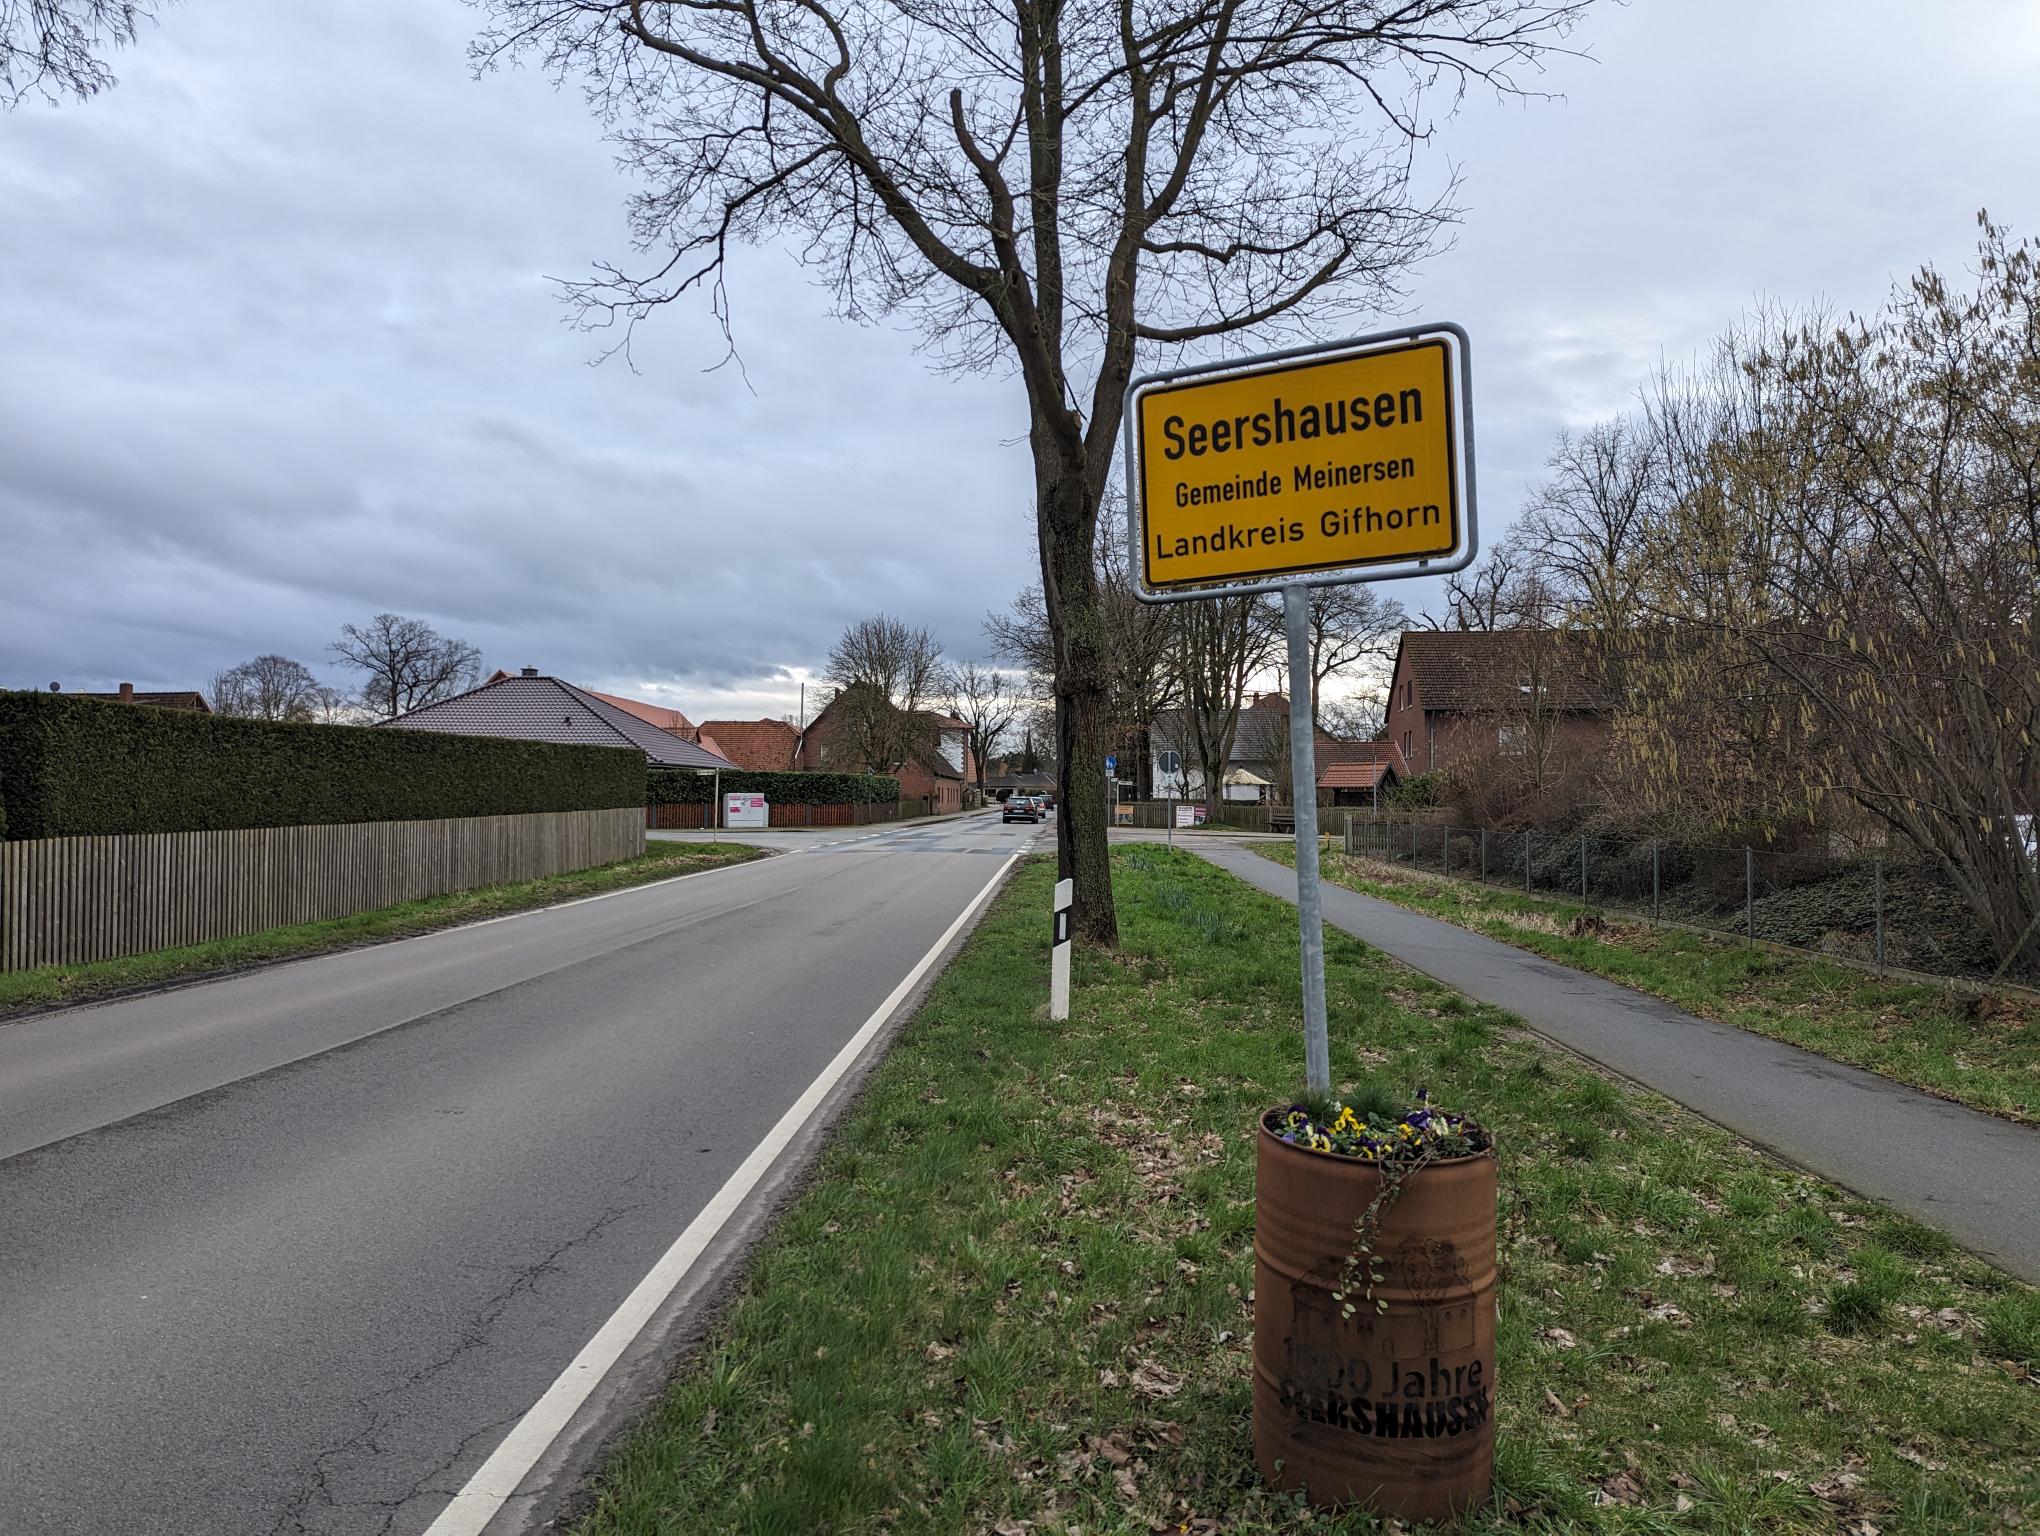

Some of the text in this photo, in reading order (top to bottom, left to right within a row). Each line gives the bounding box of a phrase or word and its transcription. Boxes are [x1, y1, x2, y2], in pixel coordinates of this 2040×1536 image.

[1163, 387, 1423, 460] Seershausen
[1175, 456, 1415, 508] Gemeinde Meinersen
[1157, 503, 1441, 559] Landkreis Gifhorn
[1382, 1357, 1483, 1398] Jahre
